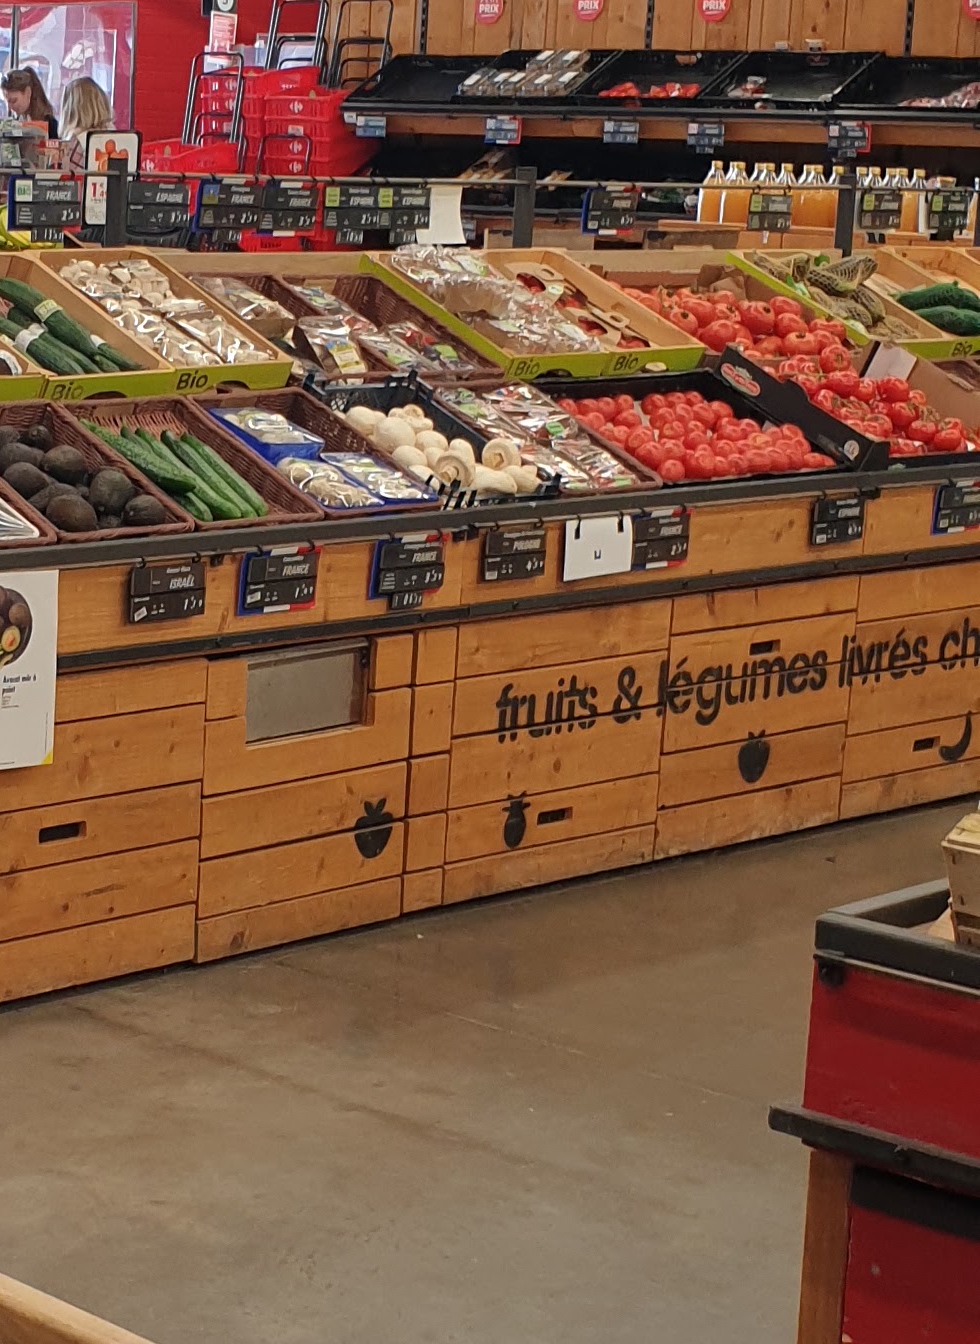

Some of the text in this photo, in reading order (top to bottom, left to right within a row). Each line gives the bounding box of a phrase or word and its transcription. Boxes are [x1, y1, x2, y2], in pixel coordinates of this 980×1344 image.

[478, 3, 500, 14] PRIX
[578, 0, 600, 11] PRIX
[702, 0, 726, 11] PRIX
[515, 358, 541, 377] Bio
[613, 353, 640, 372] Bio
[175, 370, 209, 391] Bio
[50, 382, 84, 402] Bio
[412, 550, 438, 563] FRANCE
[282, 563, 310, 577] FRANCE
[496, 674, 598, 744] fruits
[612, 666, 643, 724] &
[656, 649, 828, 726] légumes
[838, 627, 928, 689] livrés
